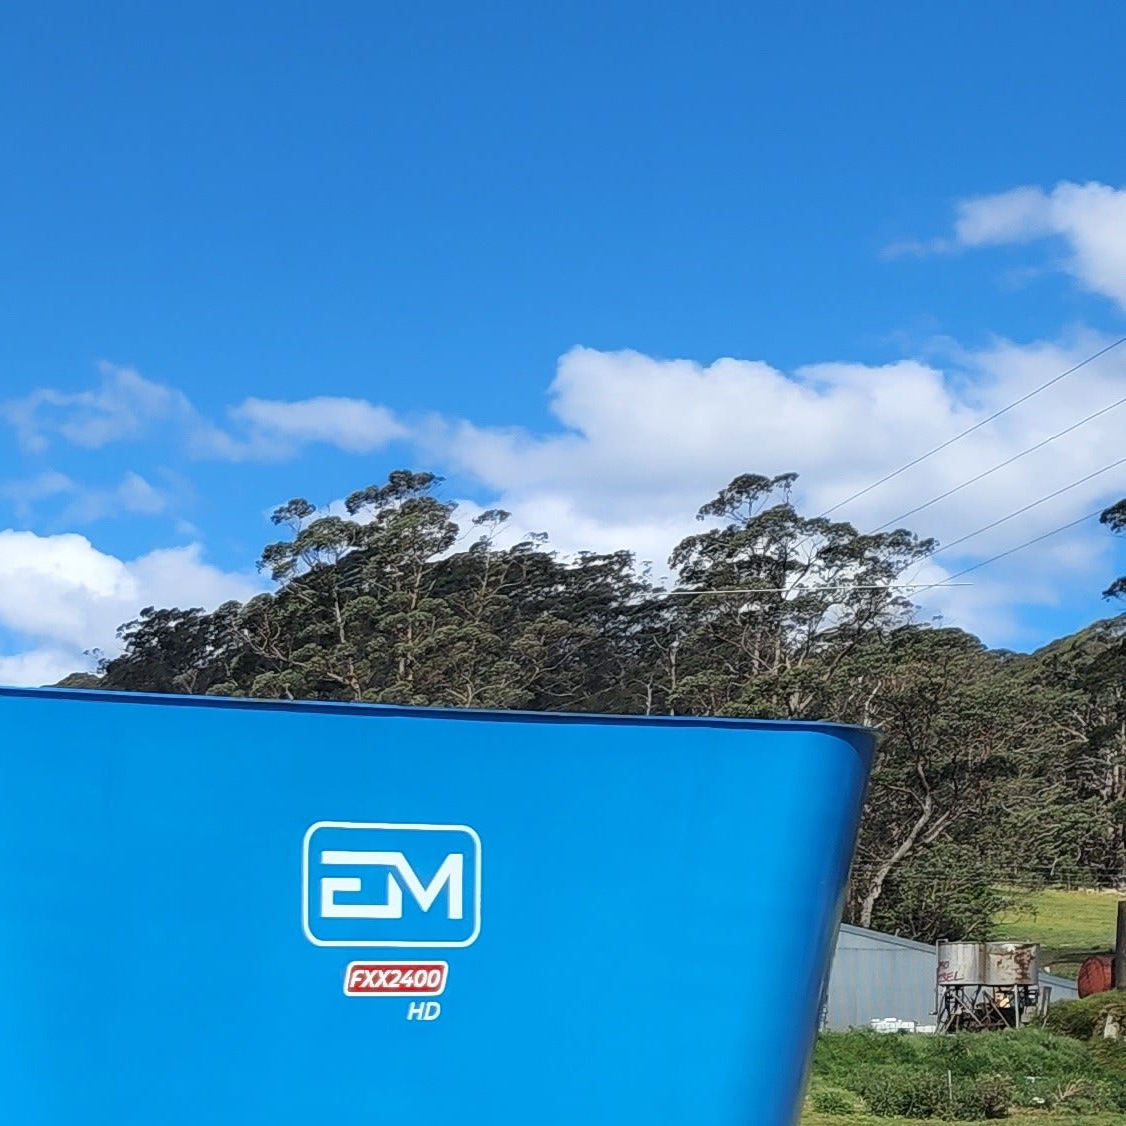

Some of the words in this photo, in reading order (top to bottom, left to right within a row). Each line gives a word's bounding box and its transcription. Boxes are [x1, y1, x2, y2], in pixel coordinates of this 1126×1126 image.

[321, 850, 464, 920] EM
[349, 969, 441, 988] FXX2400
[406, 1001, 441, 1021] HD
